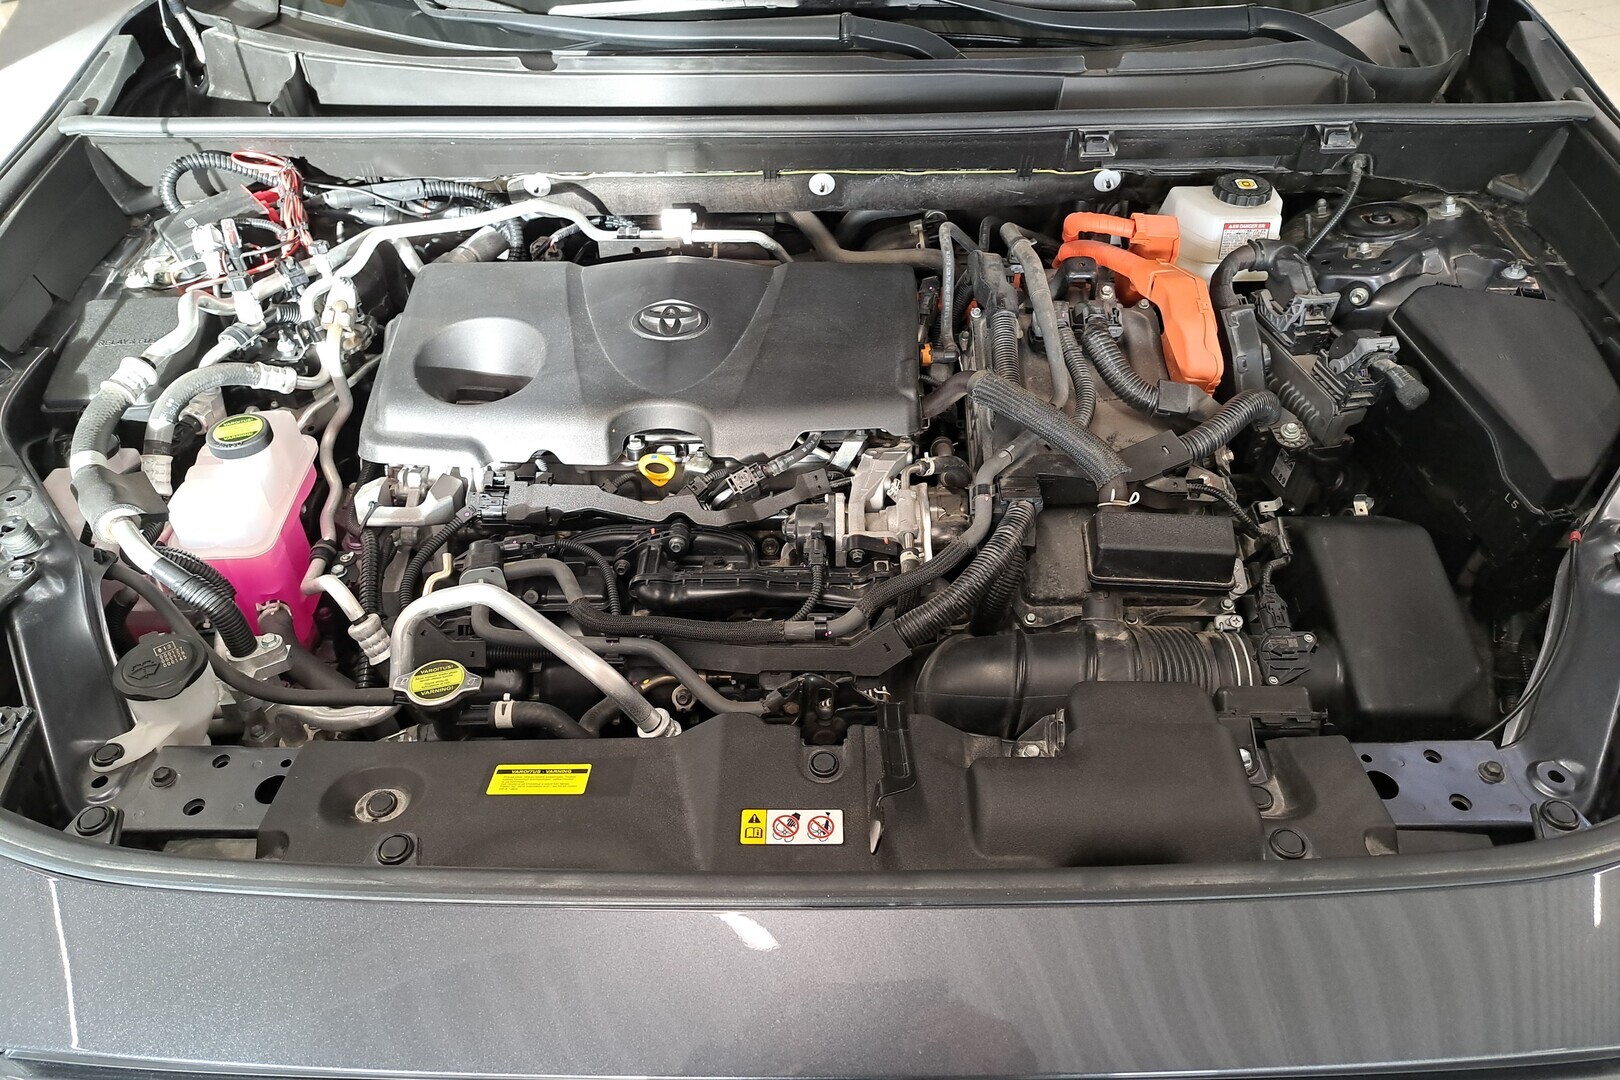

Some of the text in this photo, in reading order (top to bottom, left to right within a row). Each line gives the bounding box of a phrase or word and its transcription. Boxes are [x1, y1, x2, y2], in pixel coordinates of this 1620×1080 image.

[97, 338, 128, 347] RELAY
[138, 337, 159, 345] FUS
[420, 664, 454, 675] VAROITUS!
[420, 685, 454, 696] VARNING!
